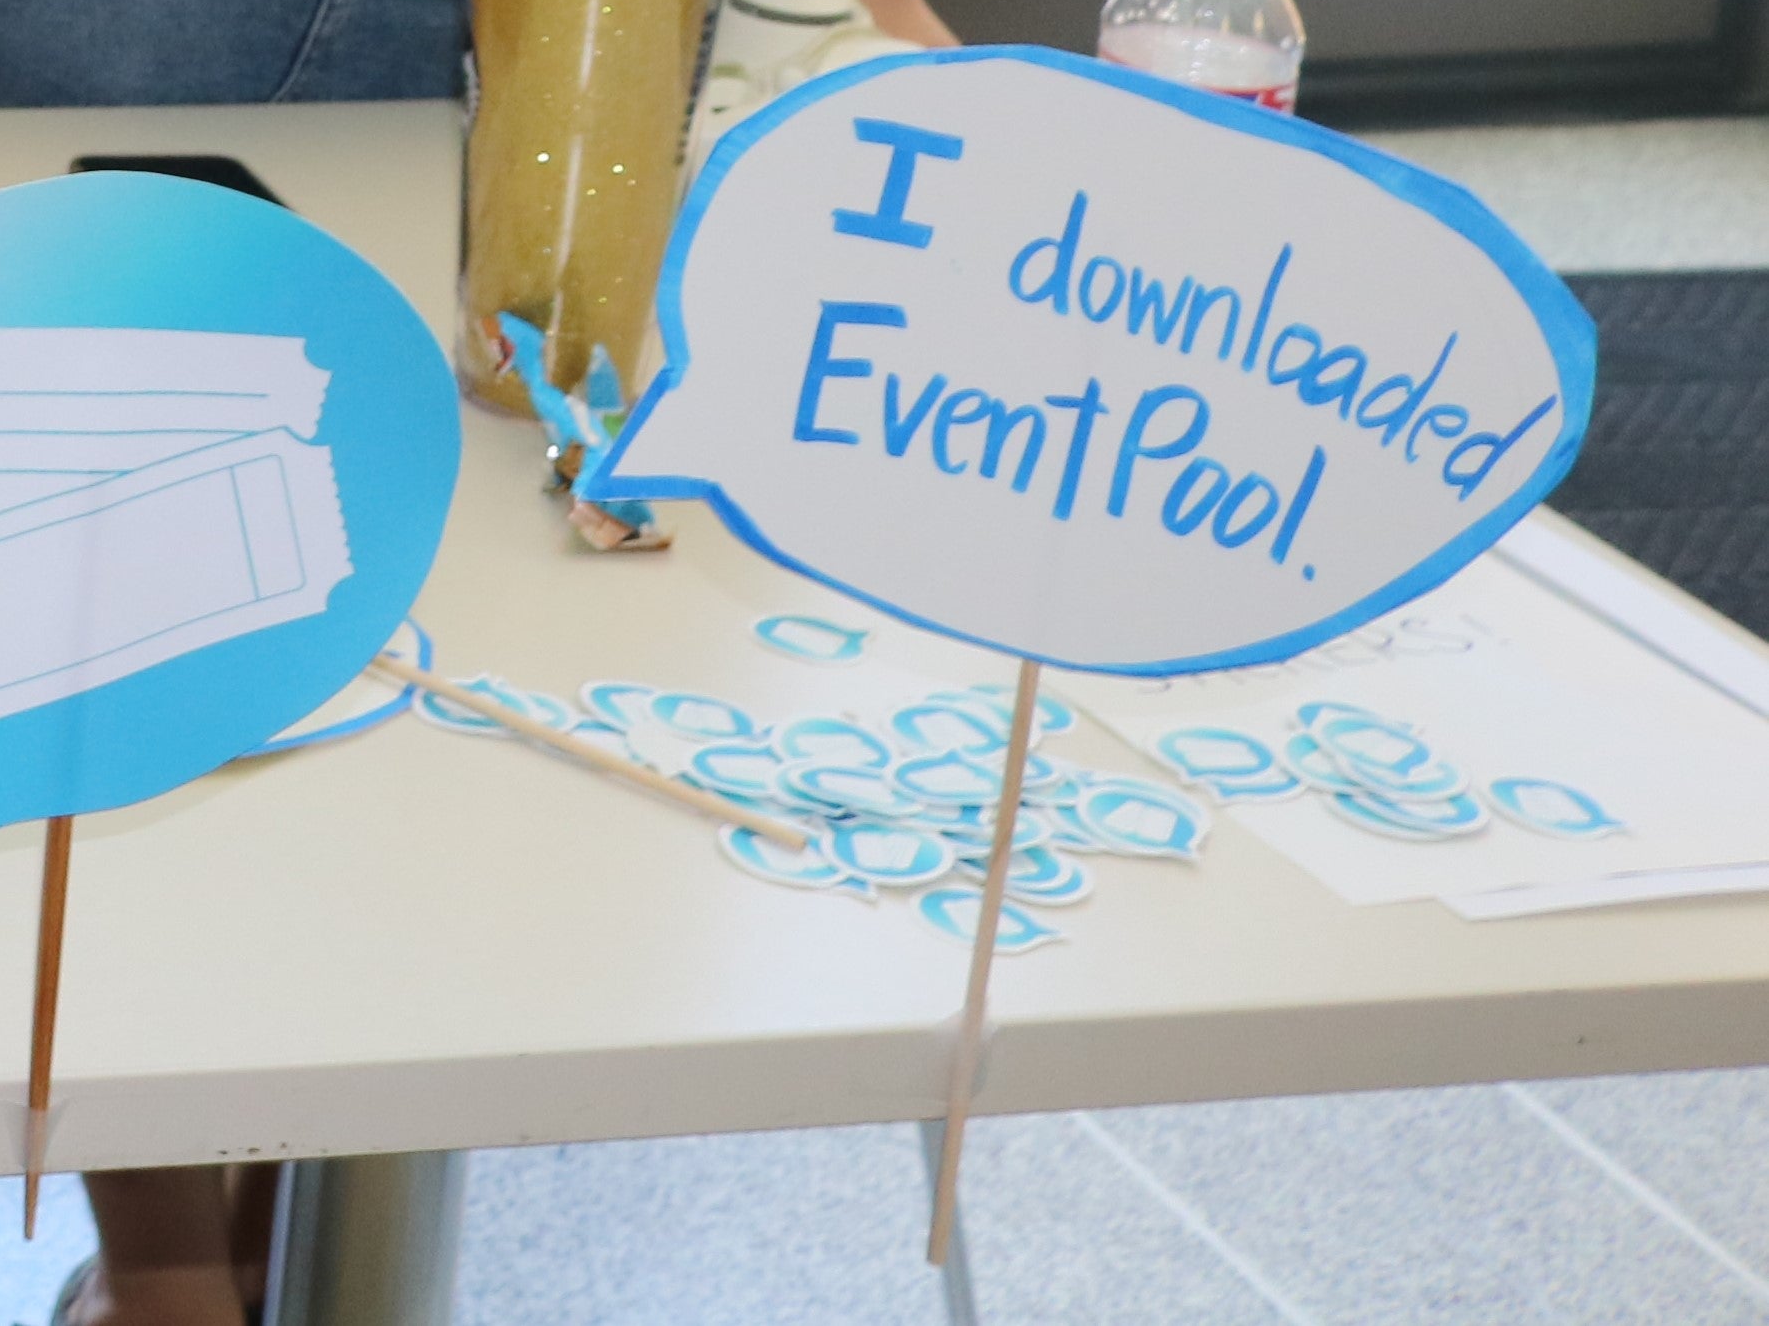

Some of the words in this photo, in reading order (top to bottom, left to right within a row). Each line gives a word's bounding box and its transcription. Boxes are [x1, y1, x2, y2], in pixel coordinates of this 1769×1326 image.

[791, 298, 1327, 582] EventPool.
[831, 116, 964, 249] I
[1008, 189, 1559, 502] downloaded
